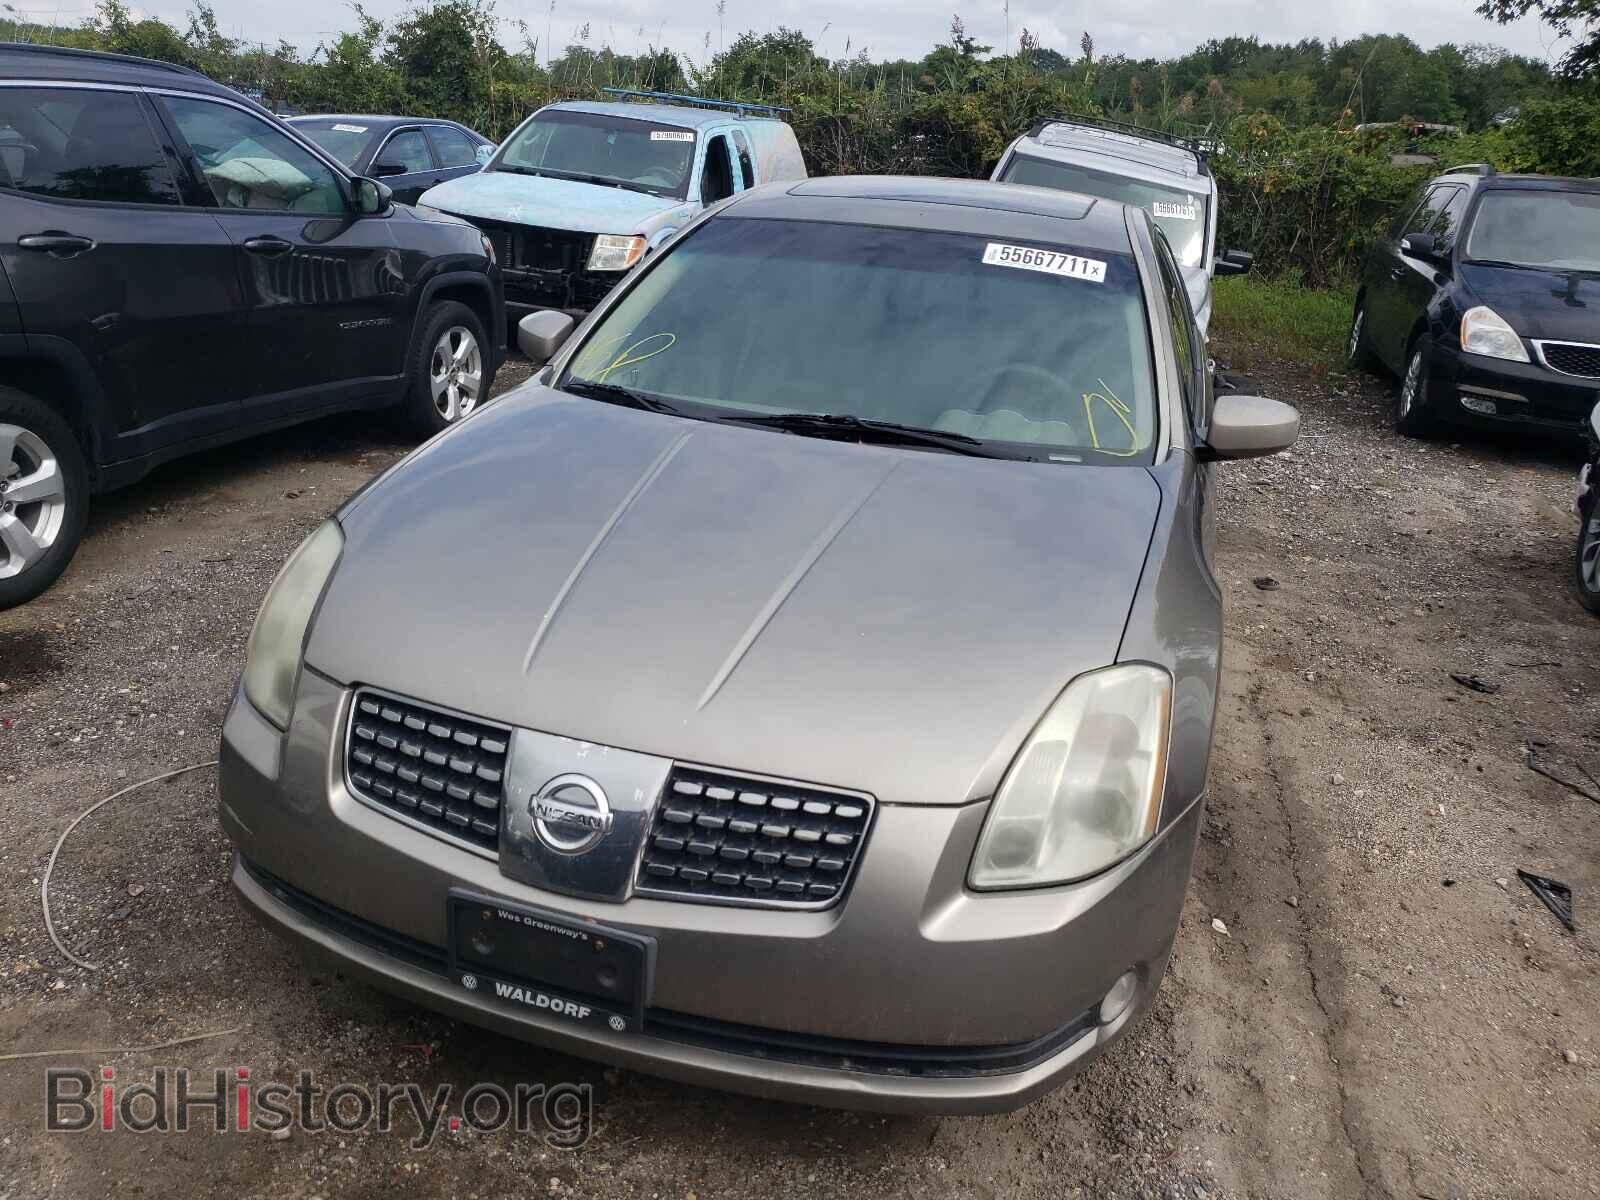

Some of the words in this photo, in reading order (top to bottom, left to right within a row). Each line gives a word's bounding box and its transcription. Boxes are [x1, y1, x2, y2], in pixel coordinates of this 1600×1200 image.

[536, 802, 602, 831] NISSAN
[497, 909, 520, 923] Wes
[524, 916, 588, 941] Greenway's
[495, 981, 592, 1020] WALDORF
